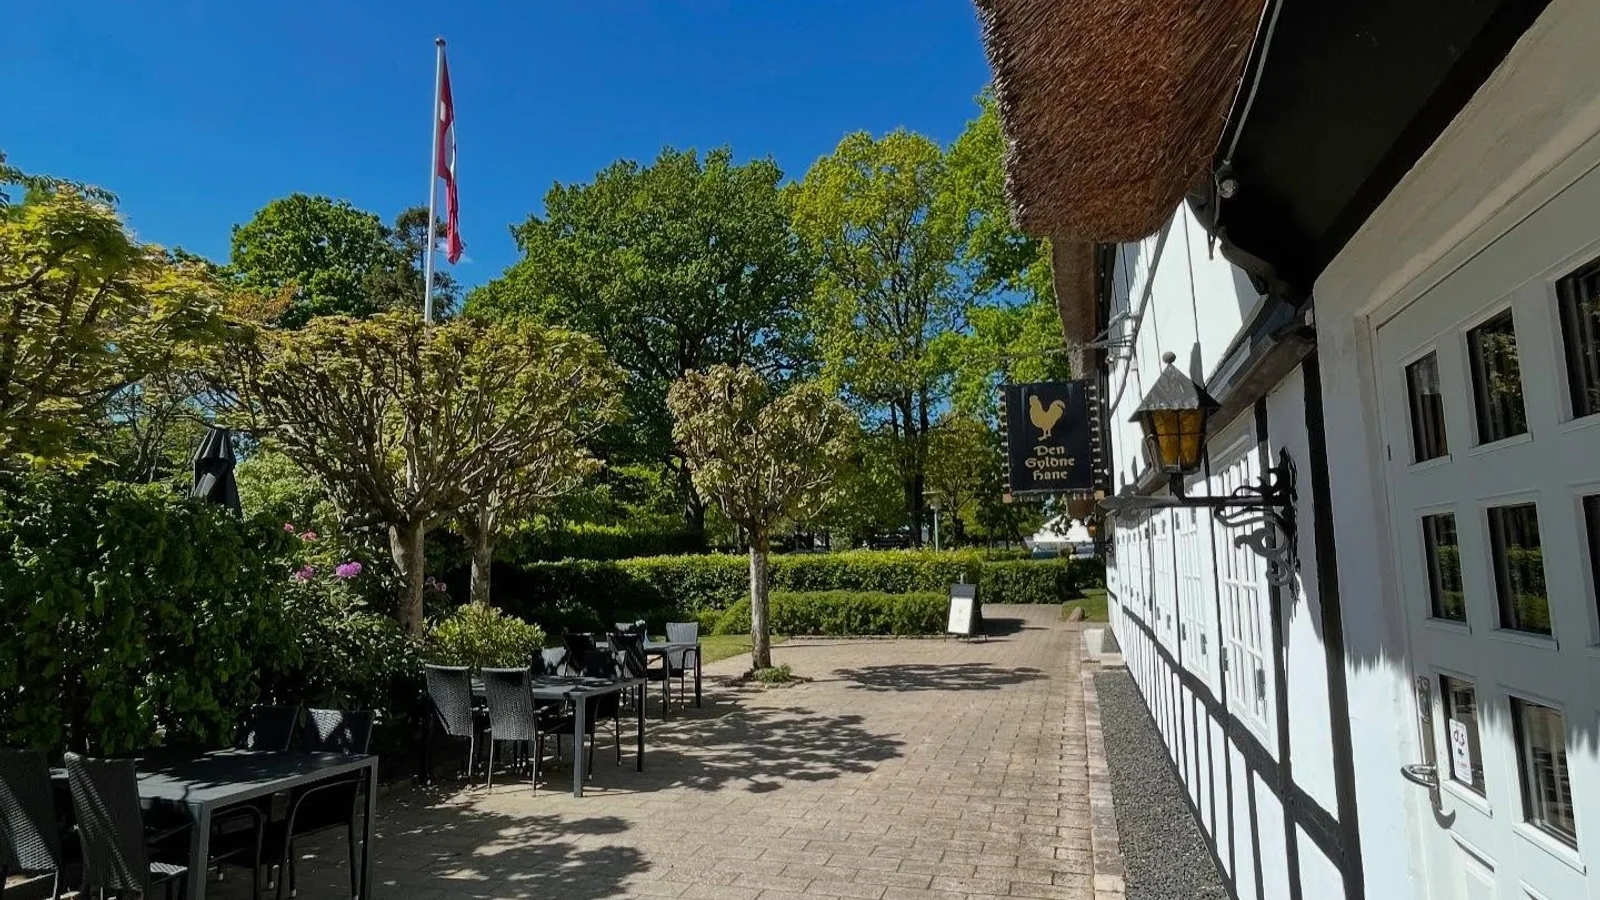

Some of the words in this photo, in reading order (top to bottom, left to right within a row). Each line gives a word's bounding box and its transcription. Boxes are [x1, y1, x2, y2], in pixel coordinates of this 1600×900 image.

[1034, 445, 1065, 456] Den
[1024, 456, 1075, 469] Gyldne
[1033, 470, 1068, 481] Hane
